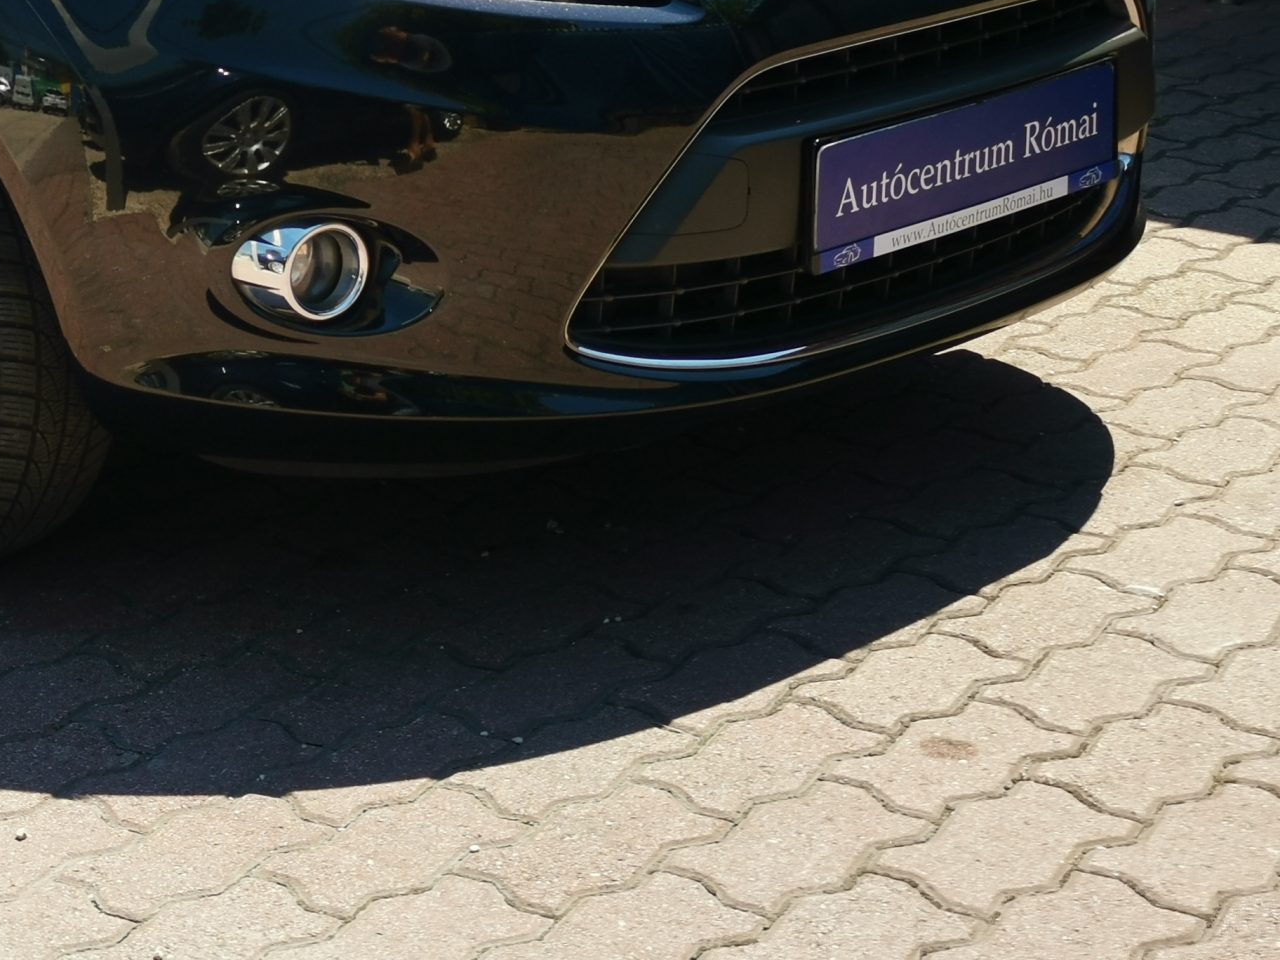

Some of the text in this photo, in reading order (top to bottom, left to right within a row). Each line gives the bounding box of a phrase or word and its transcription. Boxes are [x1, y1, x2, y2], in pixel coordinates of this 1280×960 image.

[835, 102, 1099, 218] Autócentrum Római
[890, 184, 1054, 249] www.AutócentrumRómai.hu
